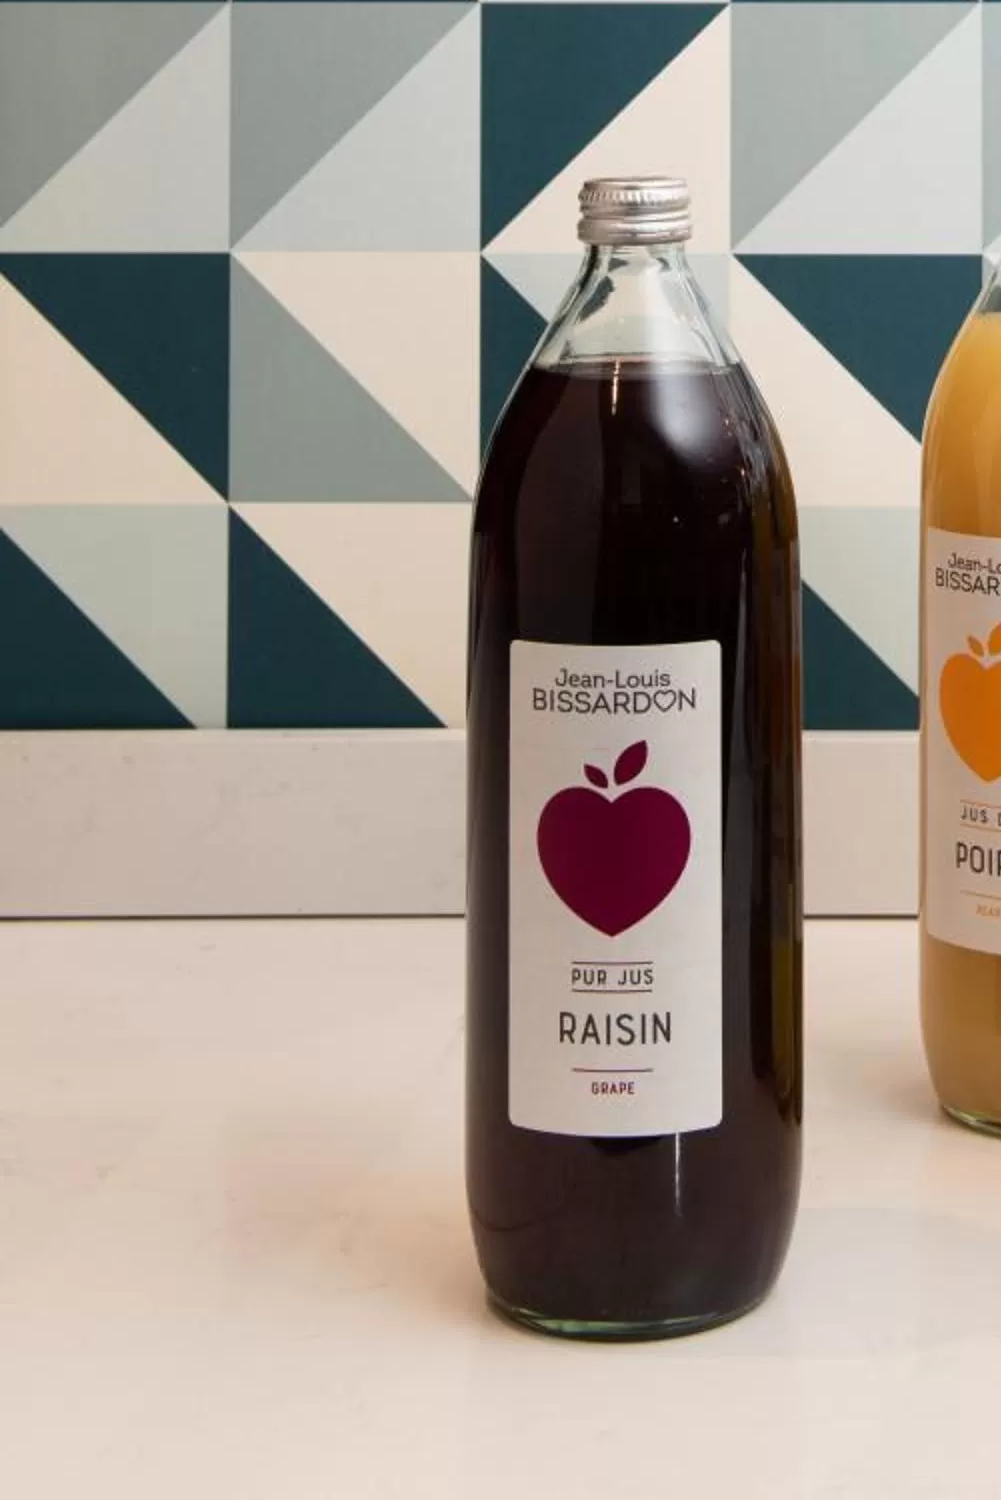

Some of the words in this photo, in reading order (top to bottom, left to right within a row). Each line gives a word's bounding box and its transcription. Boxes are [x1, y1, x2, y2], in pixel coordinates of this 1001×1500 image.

[555, 668, 671, 688] Jean-Louis
[960, 807, 988, 823] JUS
[571, 969, 608, 986] PUR
[617, 969, 654, 986] JUS
[558, 1011, 672, 1045] RAISIN
[591, 1081, 635, 1095] GRAPE
